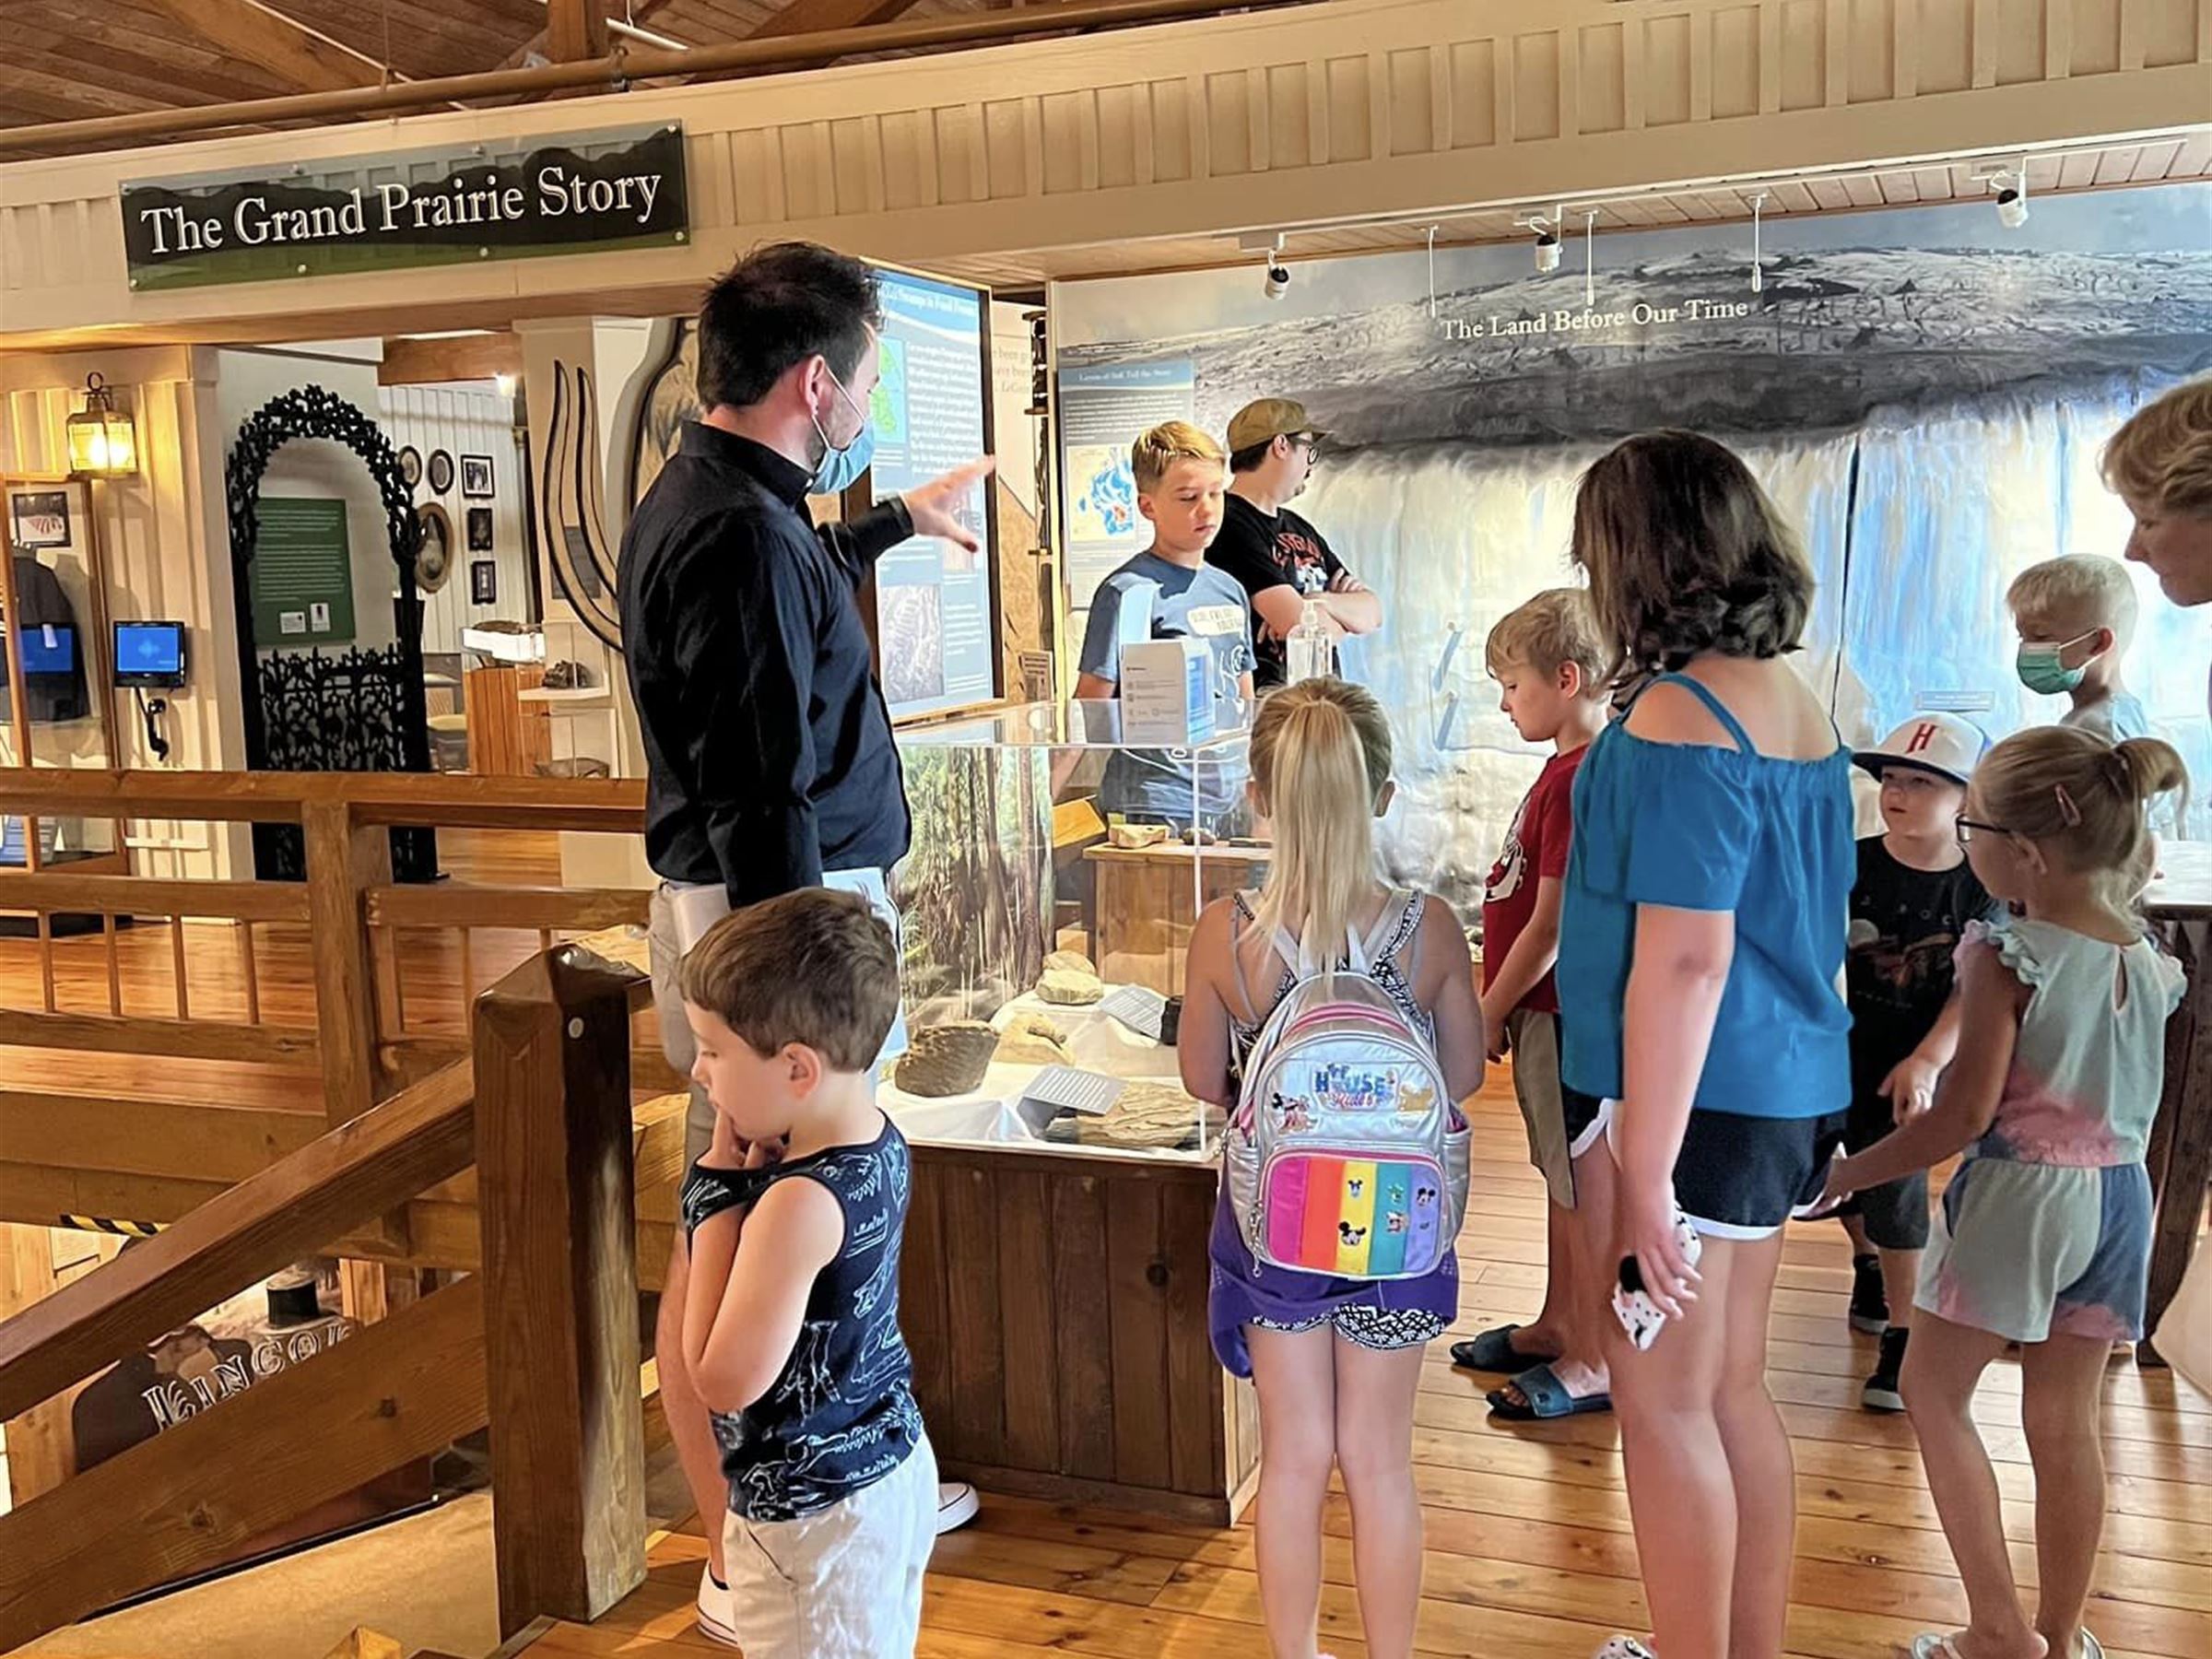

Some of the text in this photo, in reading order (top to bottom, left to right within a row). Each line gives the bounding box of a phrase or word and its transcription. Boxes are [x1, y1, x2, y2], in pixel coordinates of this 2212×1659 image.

[140, 166, 663, 253] The Grand Prairie Story
[1442, 299, 1748, 340] The Land Before Our Time
[1905, 723, 1938, 754] H
